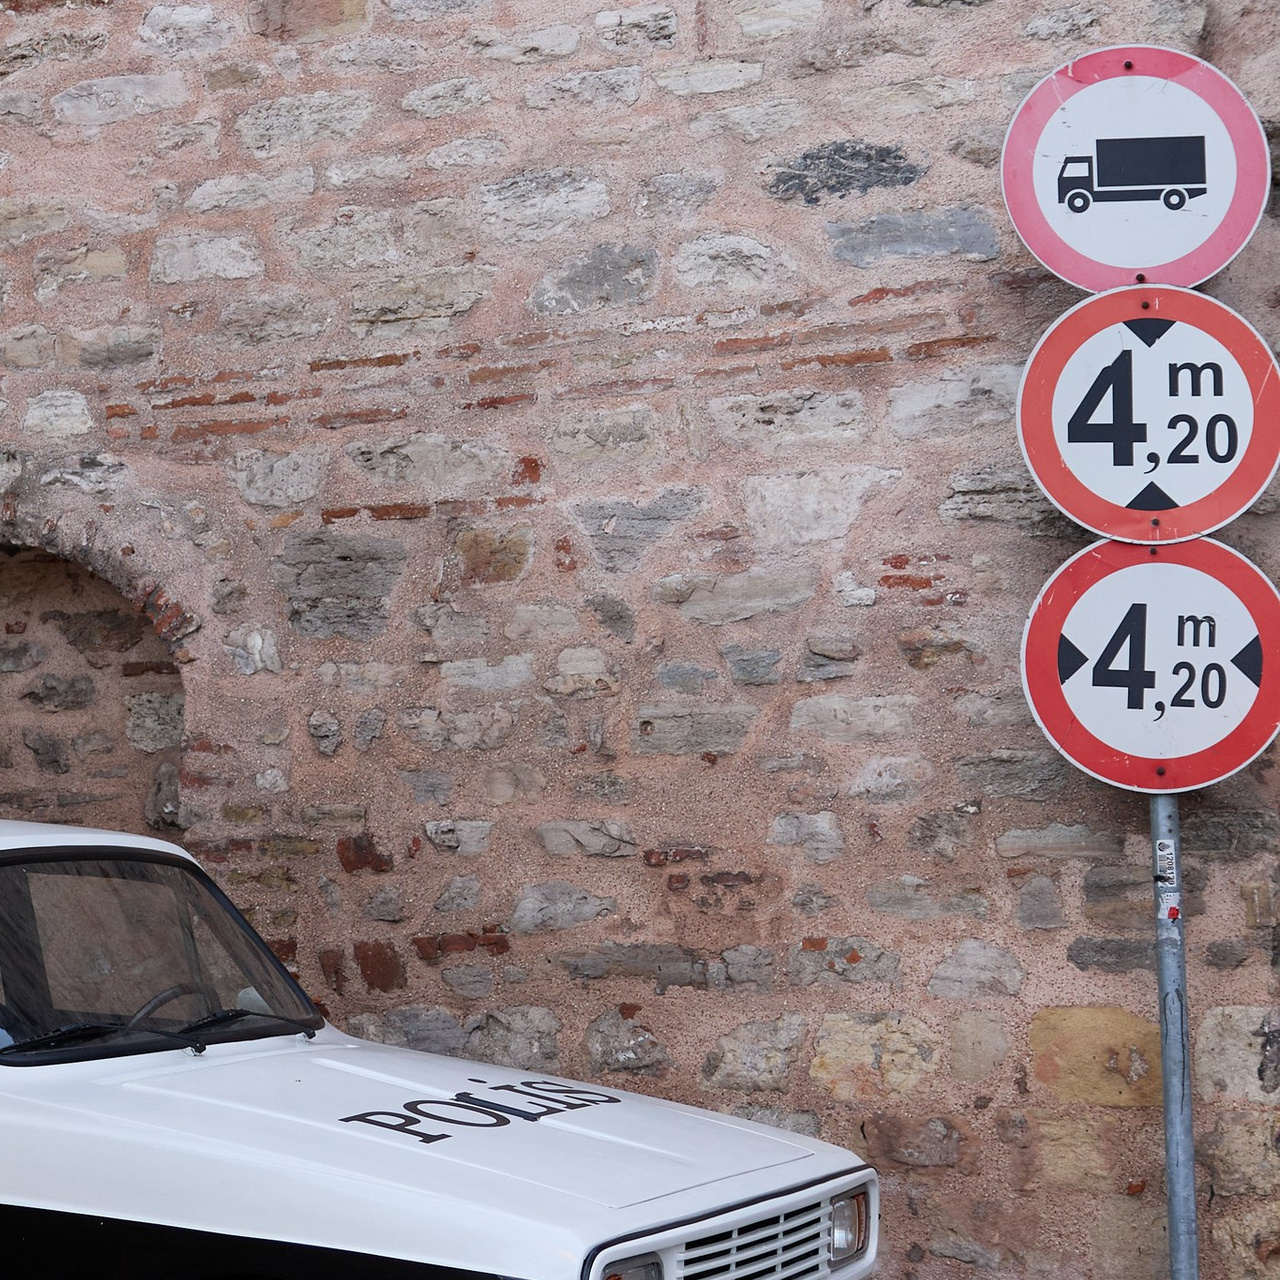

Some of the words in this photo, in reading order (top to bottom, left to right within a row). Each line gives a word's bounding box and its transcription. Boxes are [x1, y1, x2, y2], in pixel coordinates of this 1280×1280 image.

[1169, 362, 1224, 397] m
[1177, 614, 1216, 648] m
[338, 1078, 622, 1144] POLİS
